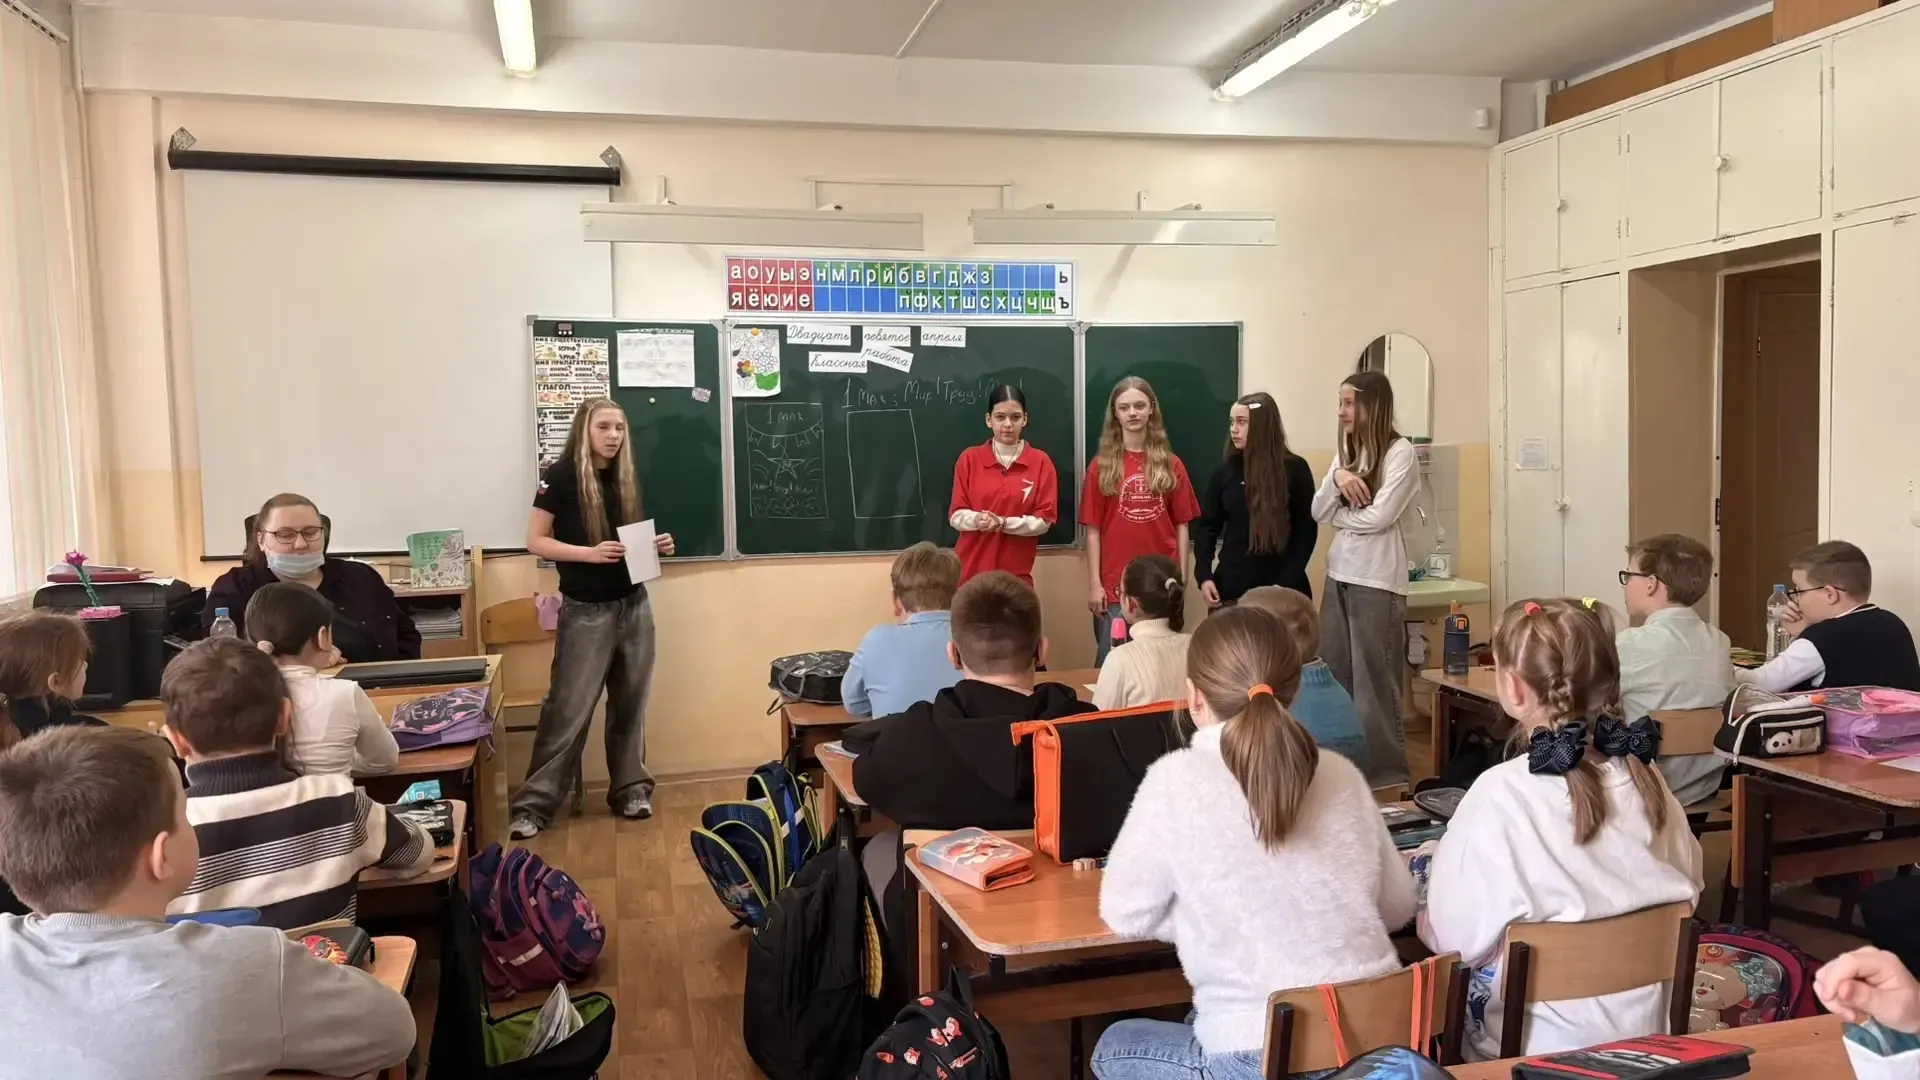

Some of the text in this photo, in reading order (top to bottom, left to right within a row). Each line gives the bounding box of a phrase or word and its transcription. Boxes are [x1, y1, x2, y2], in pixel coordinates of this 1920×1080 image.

[787, 325, 850, 344] Двадцать
[922, 333, 963, 346] апреля
[810, 348, 909, 368] Классная работа
[841, 378, 853, 408] 1
